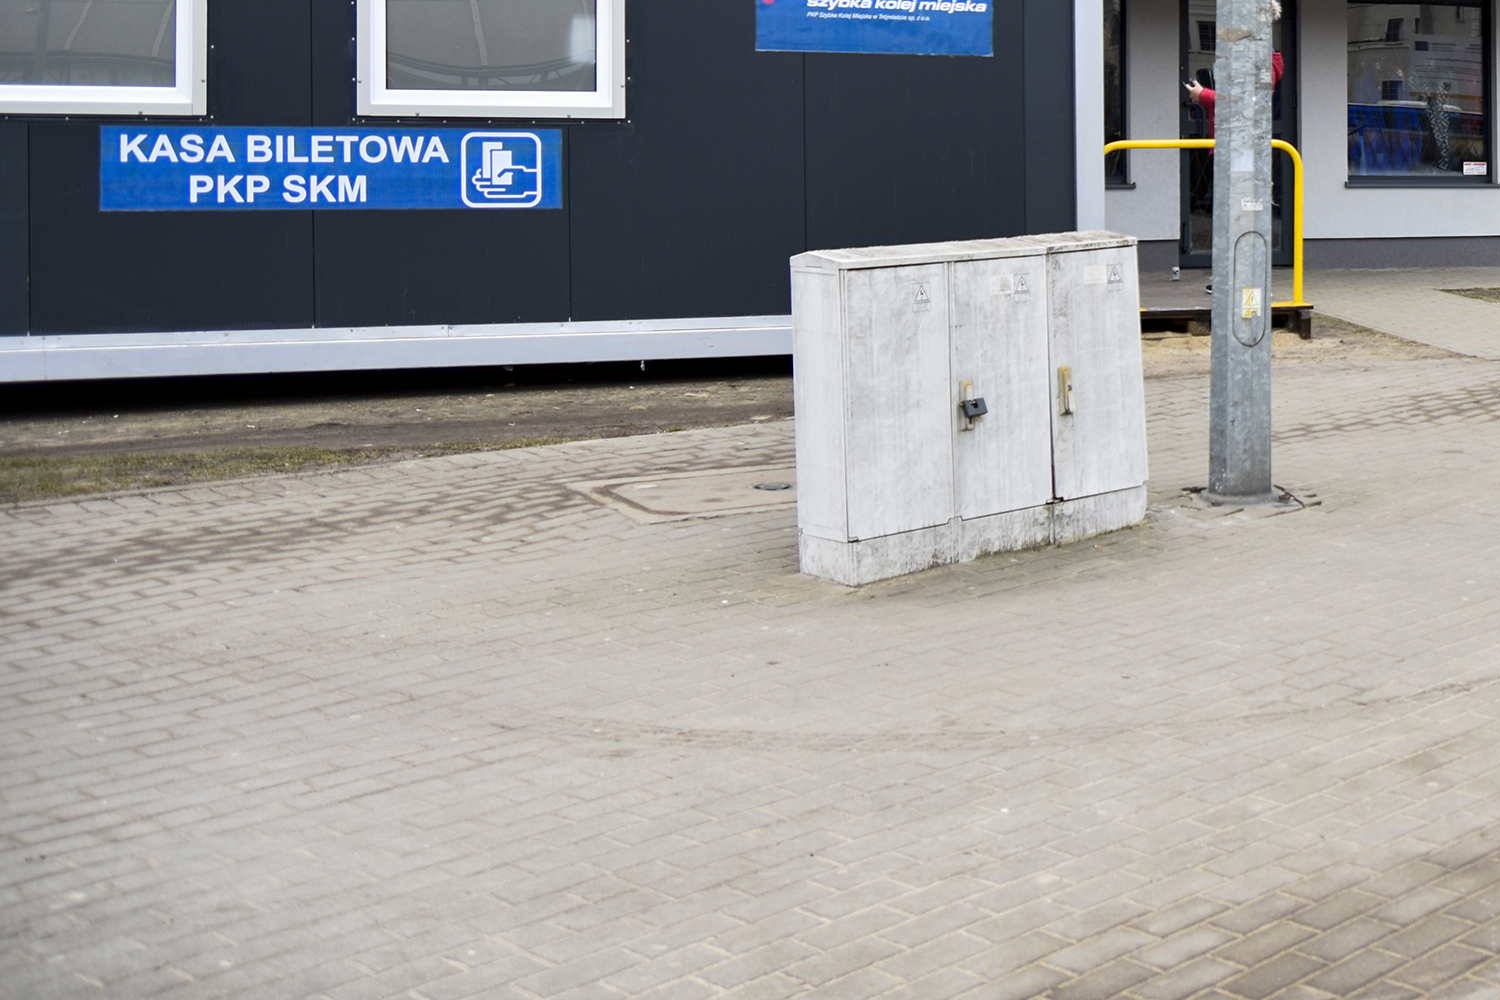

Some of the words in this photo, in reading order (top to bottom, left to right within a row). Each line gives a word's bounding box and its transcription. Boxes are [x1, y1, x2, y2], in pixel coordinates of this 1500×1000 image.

[120, 133, 236, 163] KASA
[246, 134, 450, 163] BILETOWA
[189, 175, 270, 203] PKP
[282, 174, 367, 203] SKM
